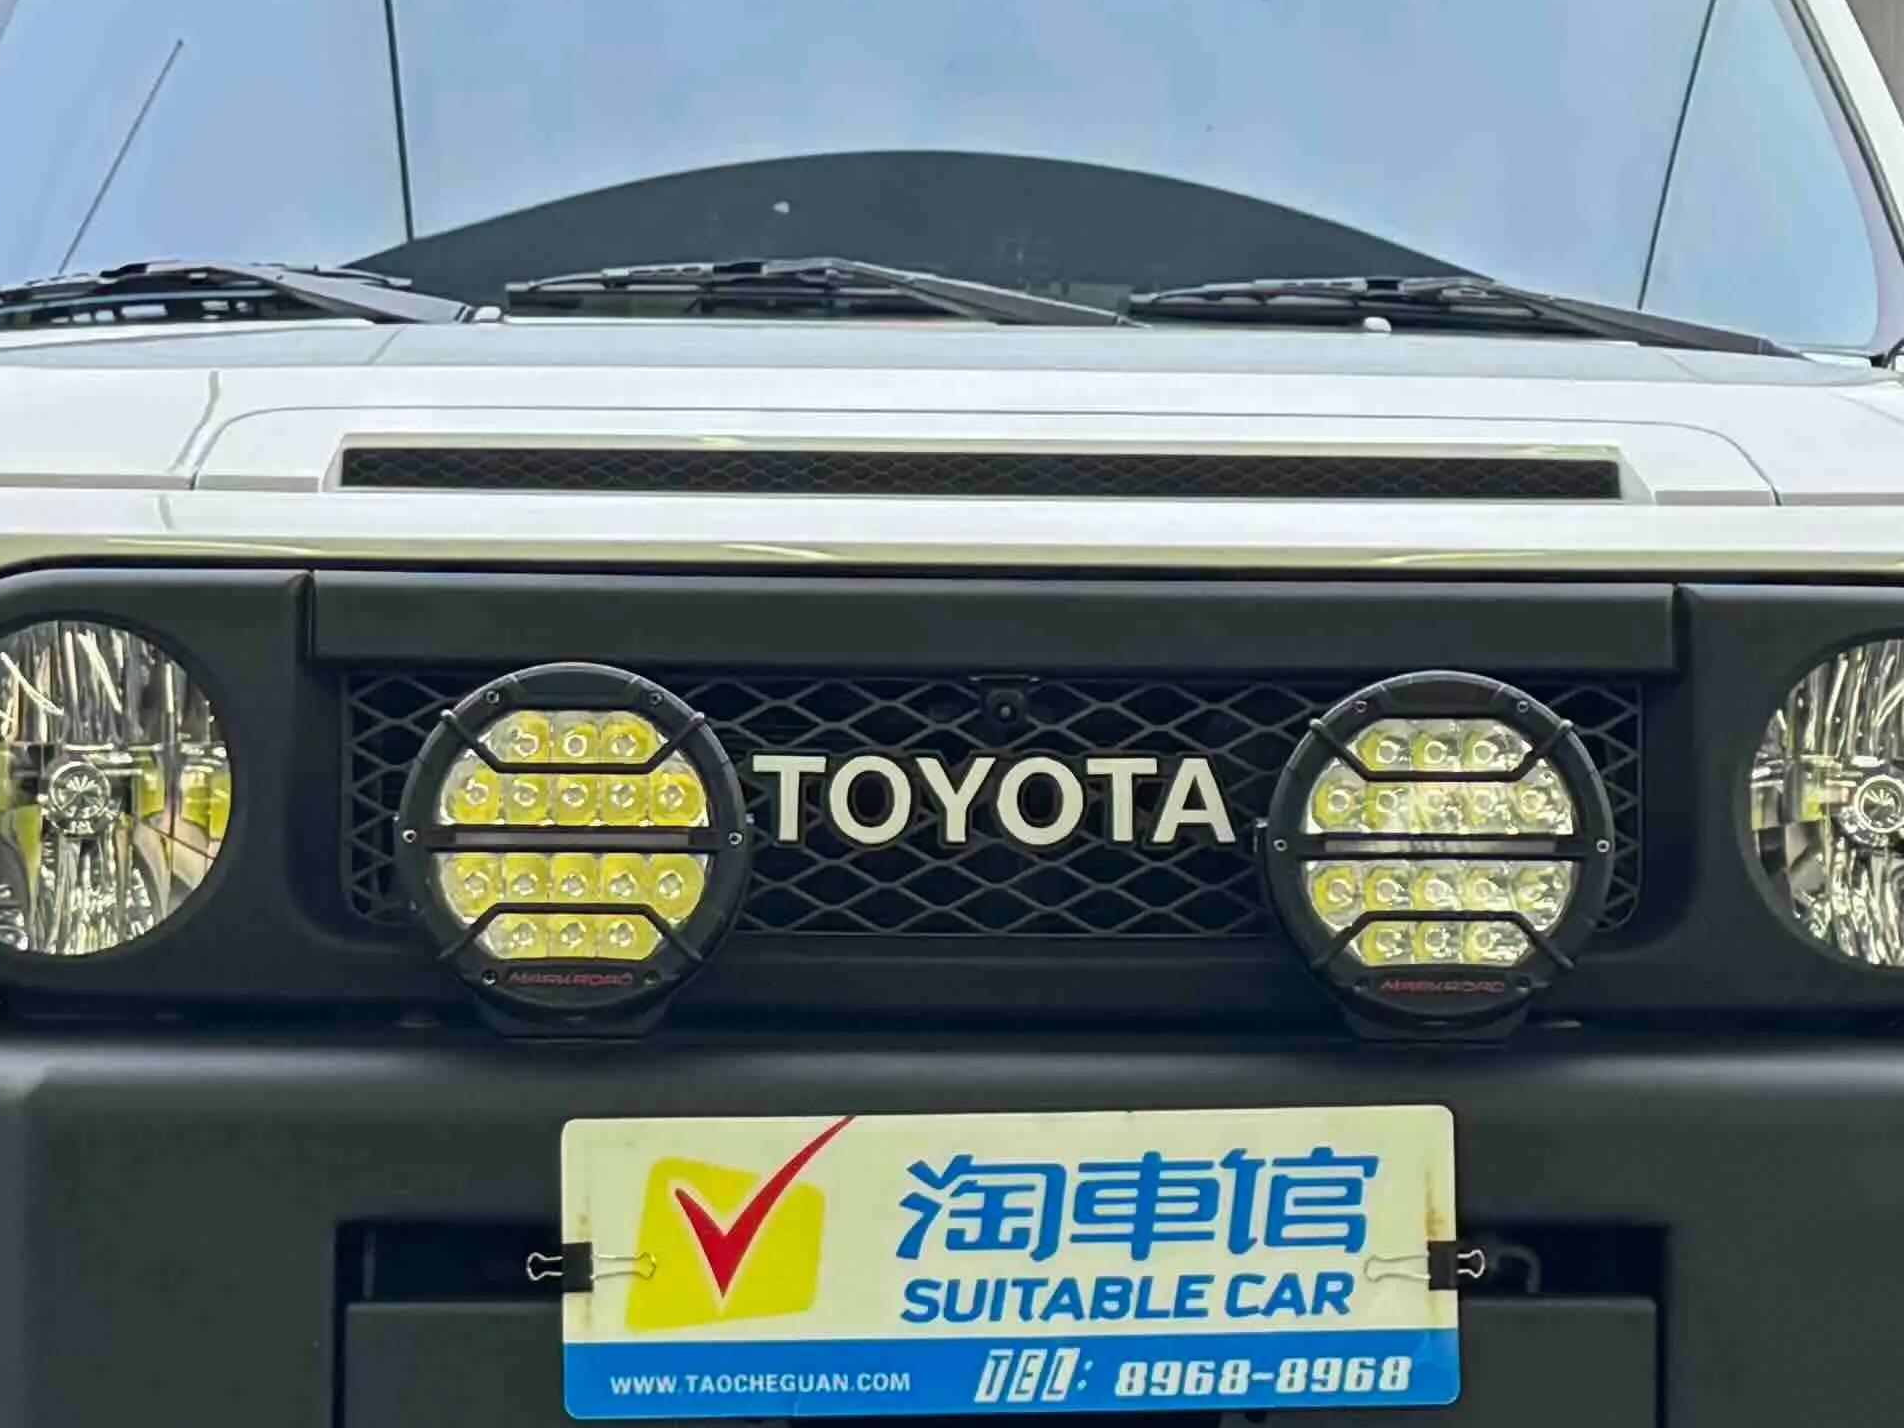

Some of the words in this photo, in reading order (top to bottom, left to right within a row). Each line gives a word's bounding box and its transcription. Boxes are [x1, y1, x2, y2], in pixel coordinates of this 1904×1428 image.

[752, 755, 1236, 845] TOYOTA
[900, 1274, 1216, 1324] SUITABLE
[1223, 1271, 1355, 1318] CAR
[609, 1372, 912, 1396] WWW.TAOCHEGUAN.COM
[1113, 1355, 1413, 1397] 8968-8968
